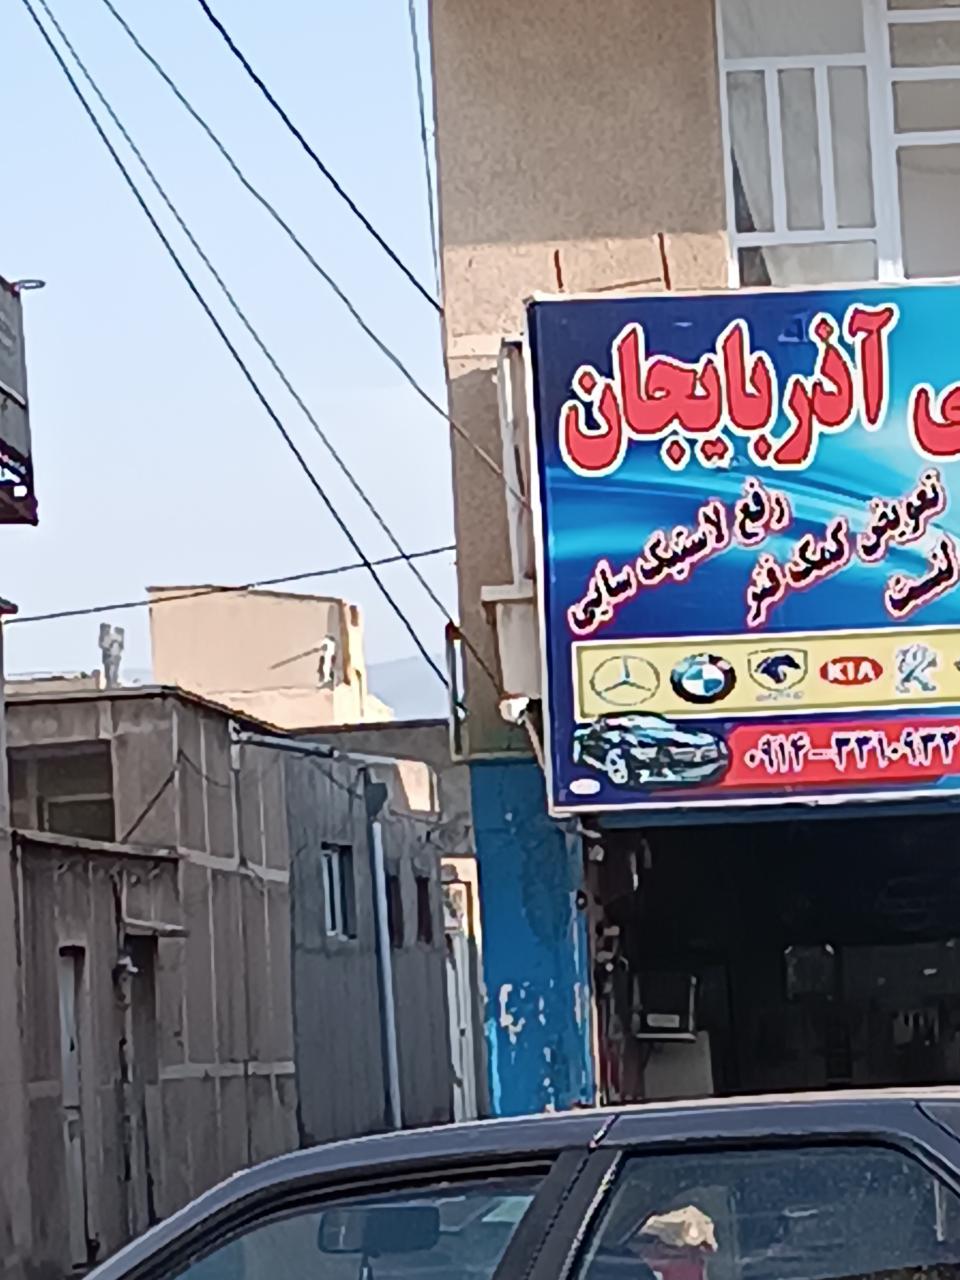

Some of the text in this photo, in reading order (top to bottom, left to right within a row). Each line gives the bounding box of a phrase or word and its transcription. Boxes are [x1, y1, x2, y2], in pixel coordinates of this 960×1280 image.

[562, 305, 897, 473] آذربایجان
[637, 501, 728, 583] لاستیک
[735, 477, 790, 544] رفع
[747, 470, 944, 625] تعویض کمک فنر
[885, 534, 959, 617] لنت
[827, 660, 876, 682] KIA
